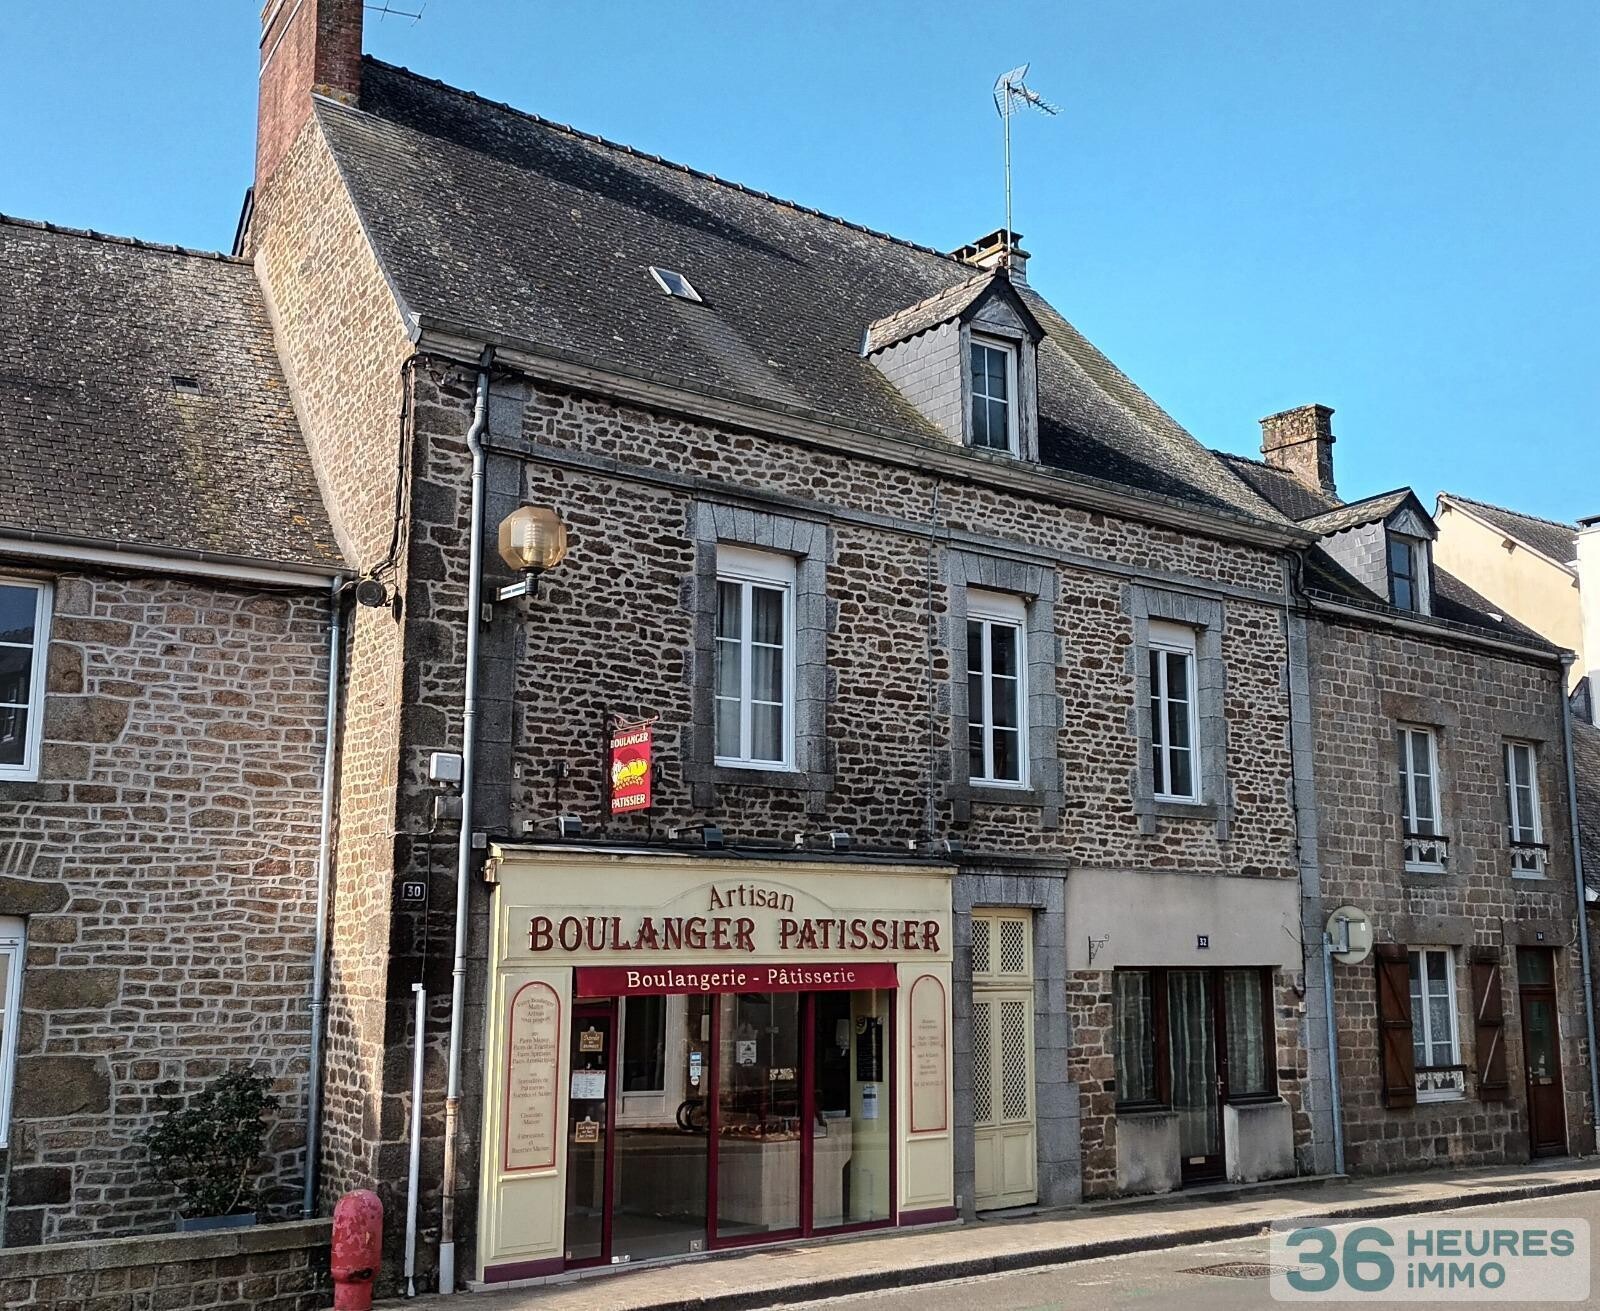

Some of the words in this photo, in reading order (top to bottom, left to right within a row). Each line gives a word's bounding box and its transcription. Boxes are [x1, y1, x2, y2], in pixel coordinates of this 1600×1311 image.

[610, 732, 648, 749] BOULANGER
[611, 794, 646, 809] PATISSIER
[407, 885, 421, 897] 30
[707, 884, 794, 912] Artisan
[528, 916, 756, 952] BOULANGER
[779, 918, 941, 952] PATISSIER
[626, 969, 747, 990] Boulangerie
[767, 967, 856, 985] Pâtisserie
